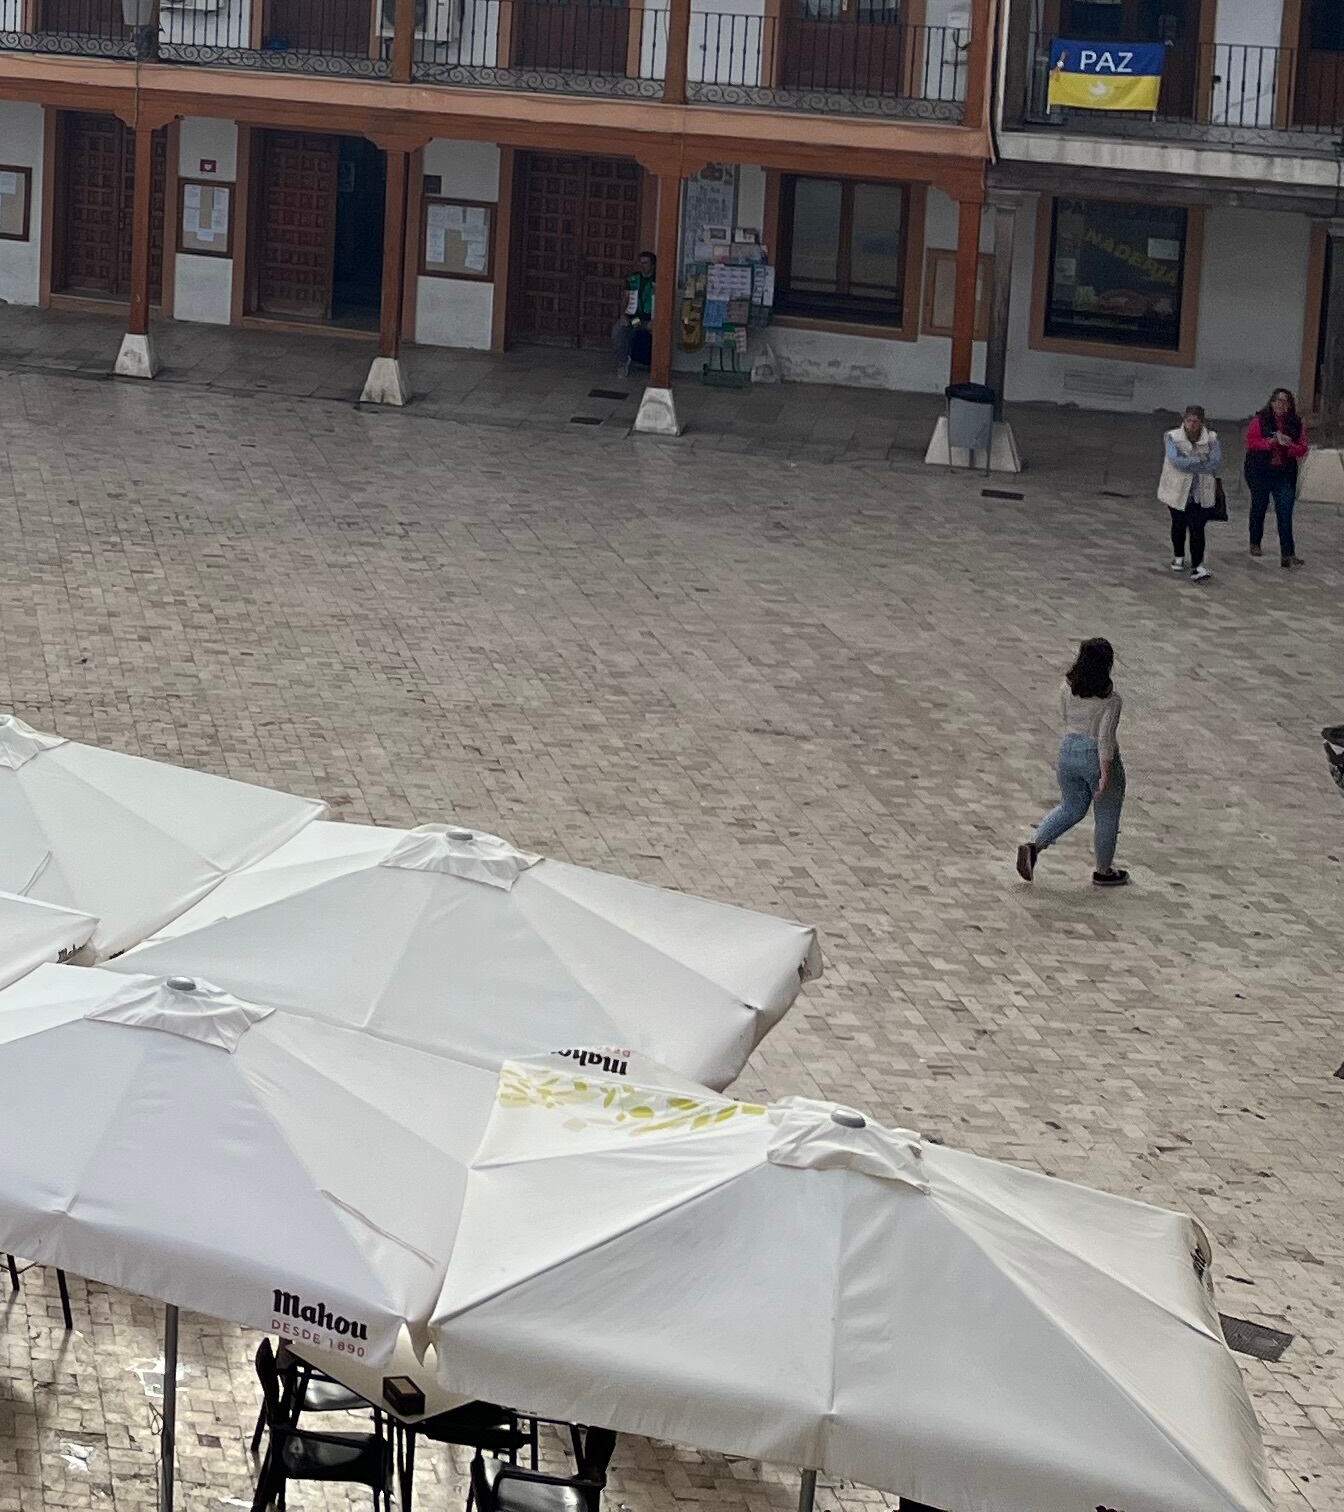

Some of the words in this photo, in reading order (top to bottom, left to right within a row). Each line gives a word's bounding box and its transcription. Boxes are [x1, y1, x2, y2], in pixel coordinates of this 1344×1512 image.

[1079, 50, 1133, 72] PAZ
[272, 1289, 368, 1340] Mahou
[271, 1319, 321, 1345] DESDE
[329, 1338, 365, 1358] 1890
